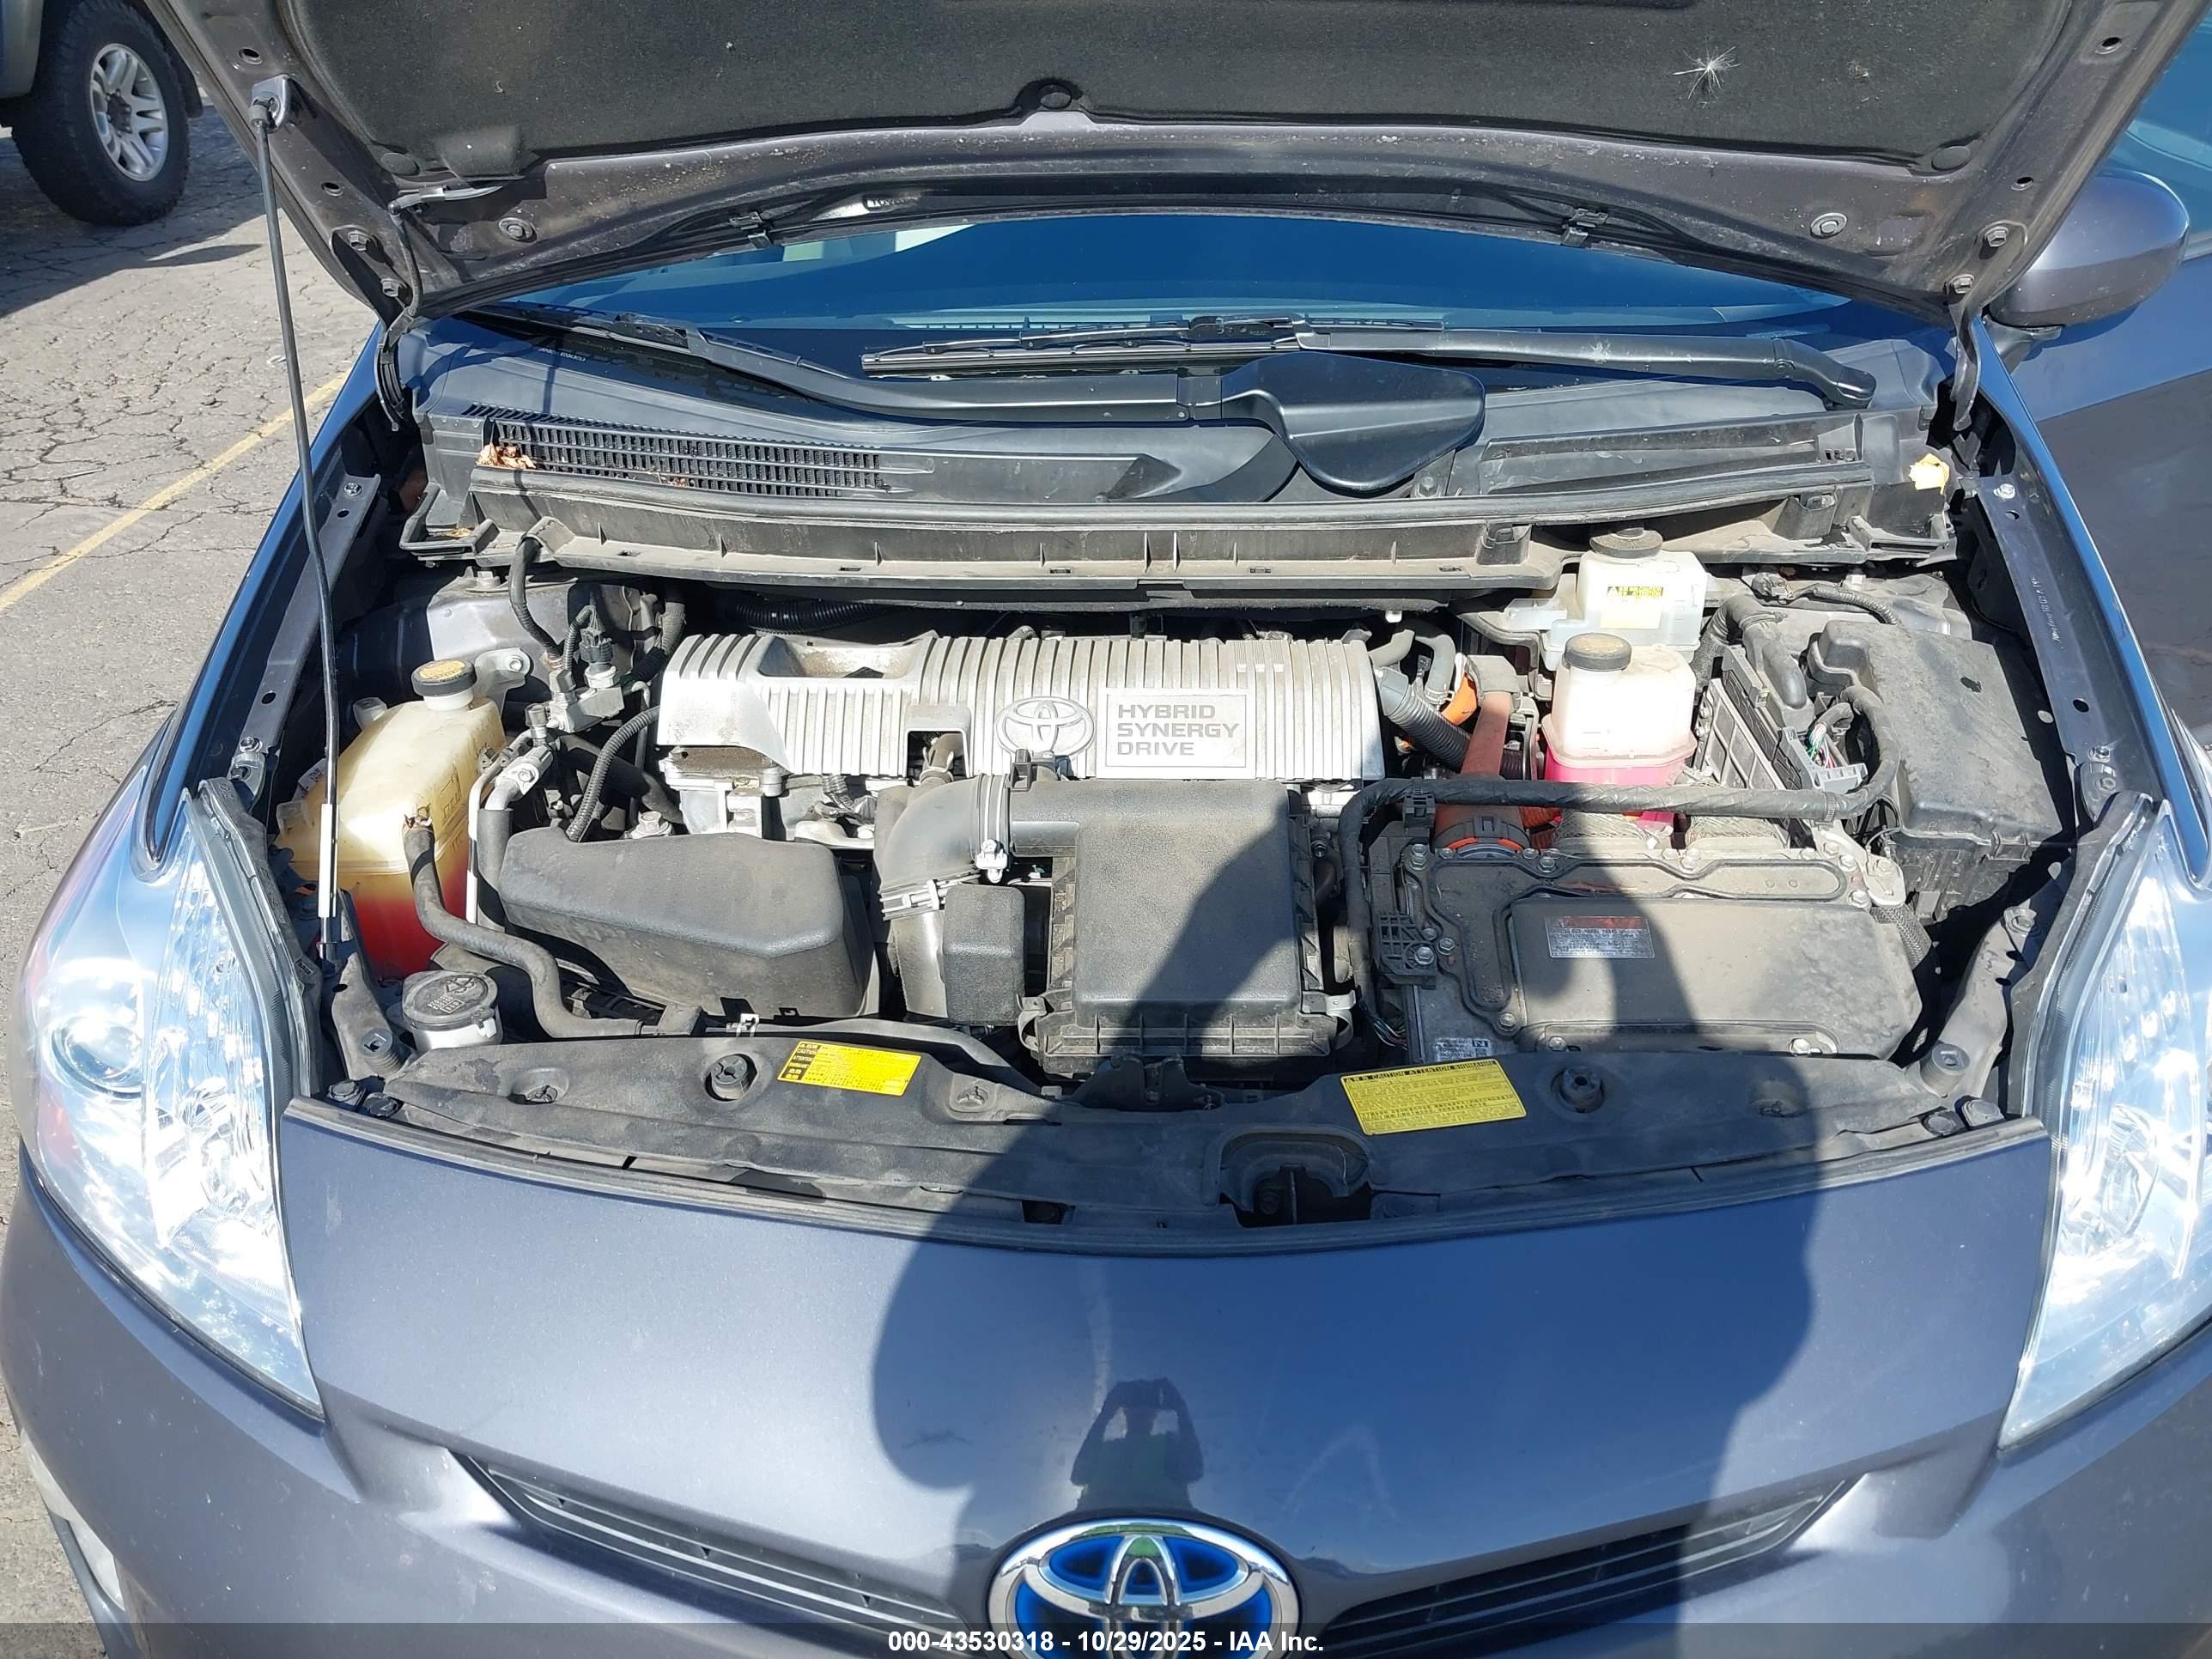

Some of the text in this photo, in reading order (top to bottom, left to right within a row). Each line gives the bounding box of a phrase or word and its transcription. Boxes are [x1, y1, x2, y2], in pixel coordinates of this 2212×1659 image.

[1118, 704, 1216, 719] HYBRID
[1117, 722, 1239, 738] SYNERGY
[1117, 741, 1195, 756] DRIVE
[1372, 1070, 1406, 1080] CAUTION
[1409, 1065, 1451, 1075] ATTENTION
